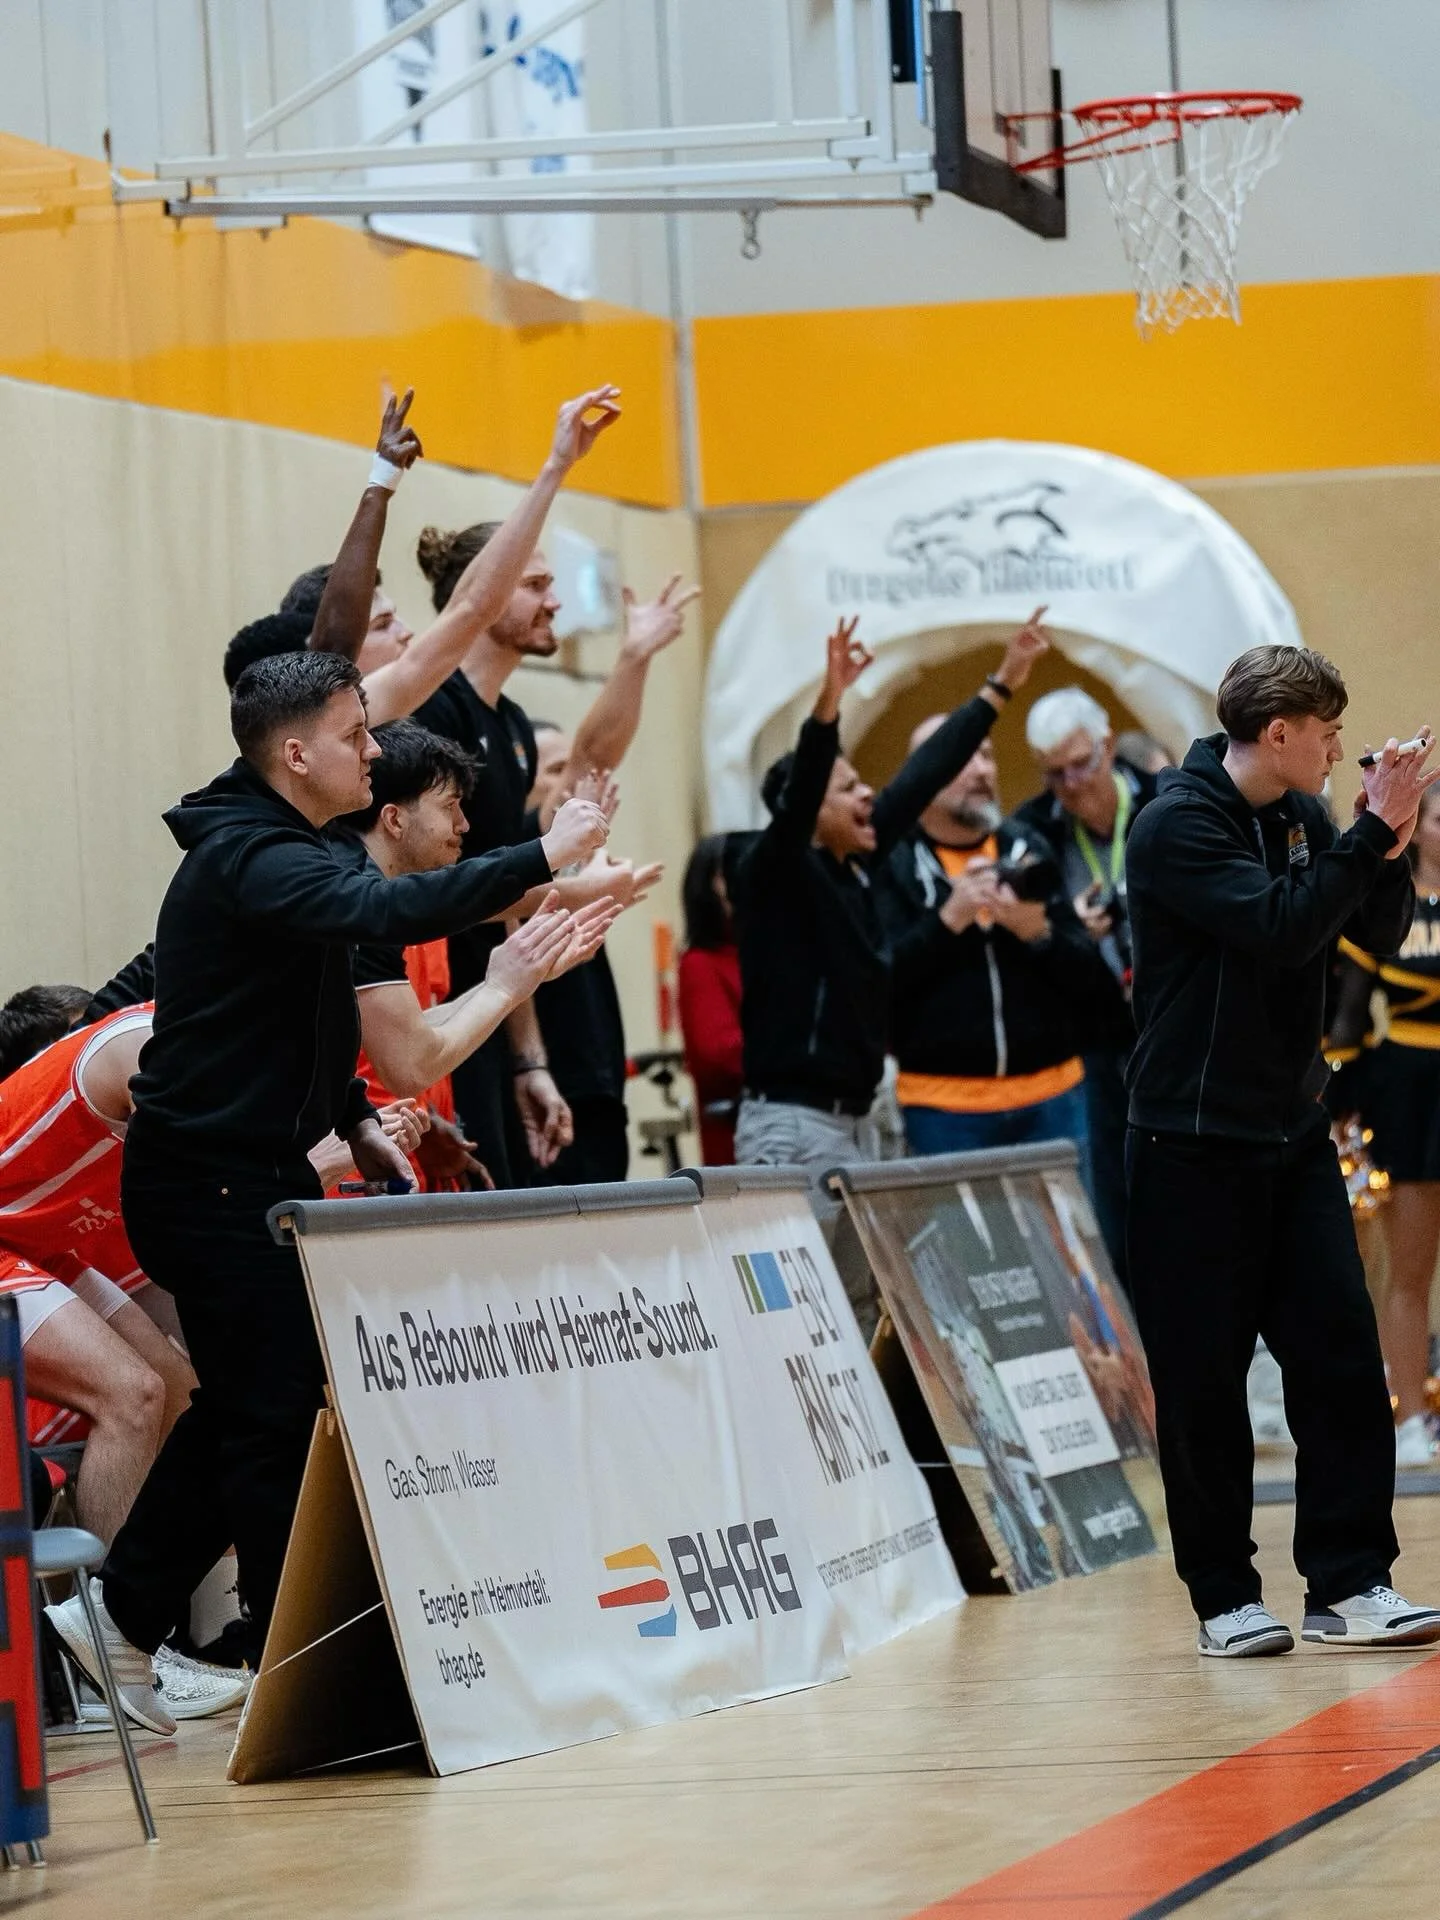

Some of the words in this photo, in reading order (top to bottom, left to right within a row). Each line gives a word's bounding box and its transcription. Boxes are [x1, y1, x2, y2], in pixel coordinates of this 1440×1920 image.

[355, 1315, 407, 1393] Aus
[400, 1303, 510, 1387] Rebound
[504, 1299, 560, 1376] wird
[550, 1281, 719, 1369] Heimat-Sound.
[416, 1454, 461, 1498] Strom,
[452, 1448, 500, 1489] Wasser
[667, 1517, 803, 1631] BHAG
[418, 1583, 469, 1629] Energie
[435, 1642, 486, 1689] bhag.de
